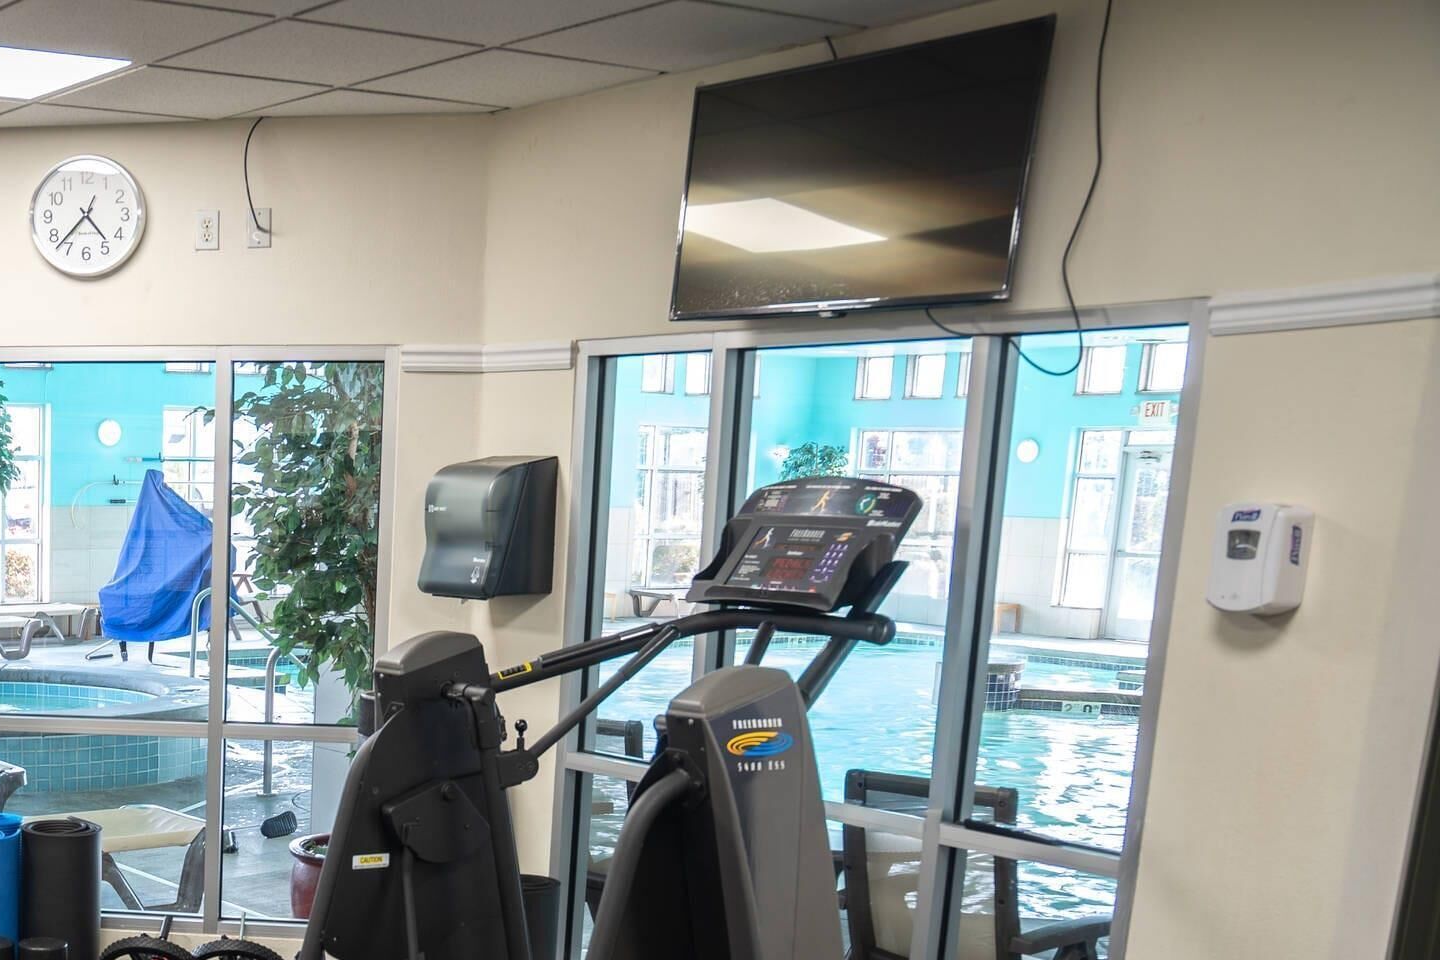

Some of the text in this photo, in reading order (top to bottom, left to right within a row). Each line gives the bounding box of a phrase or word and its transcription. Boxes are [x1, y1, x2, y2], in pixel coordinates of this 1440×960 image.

[61, 177, 73, 191] 11
[81, 171, 94, 185] 12
[102, 176, 108, 190] 1
[49, 191, 64, 206] 10
[115, 189, 125, 204] 2
[43, 209, 53, 224] 9
[120, 207, 130, 222] 3
[49, 228, 59, 243] 8
[113, 226, 124, 241] 4
[63, 241, 74, 256] 7
[81, 246, 91, 261] 6
[100, 240, 110, 256] 5
[1145, 402, 1165, 417] EXIT
